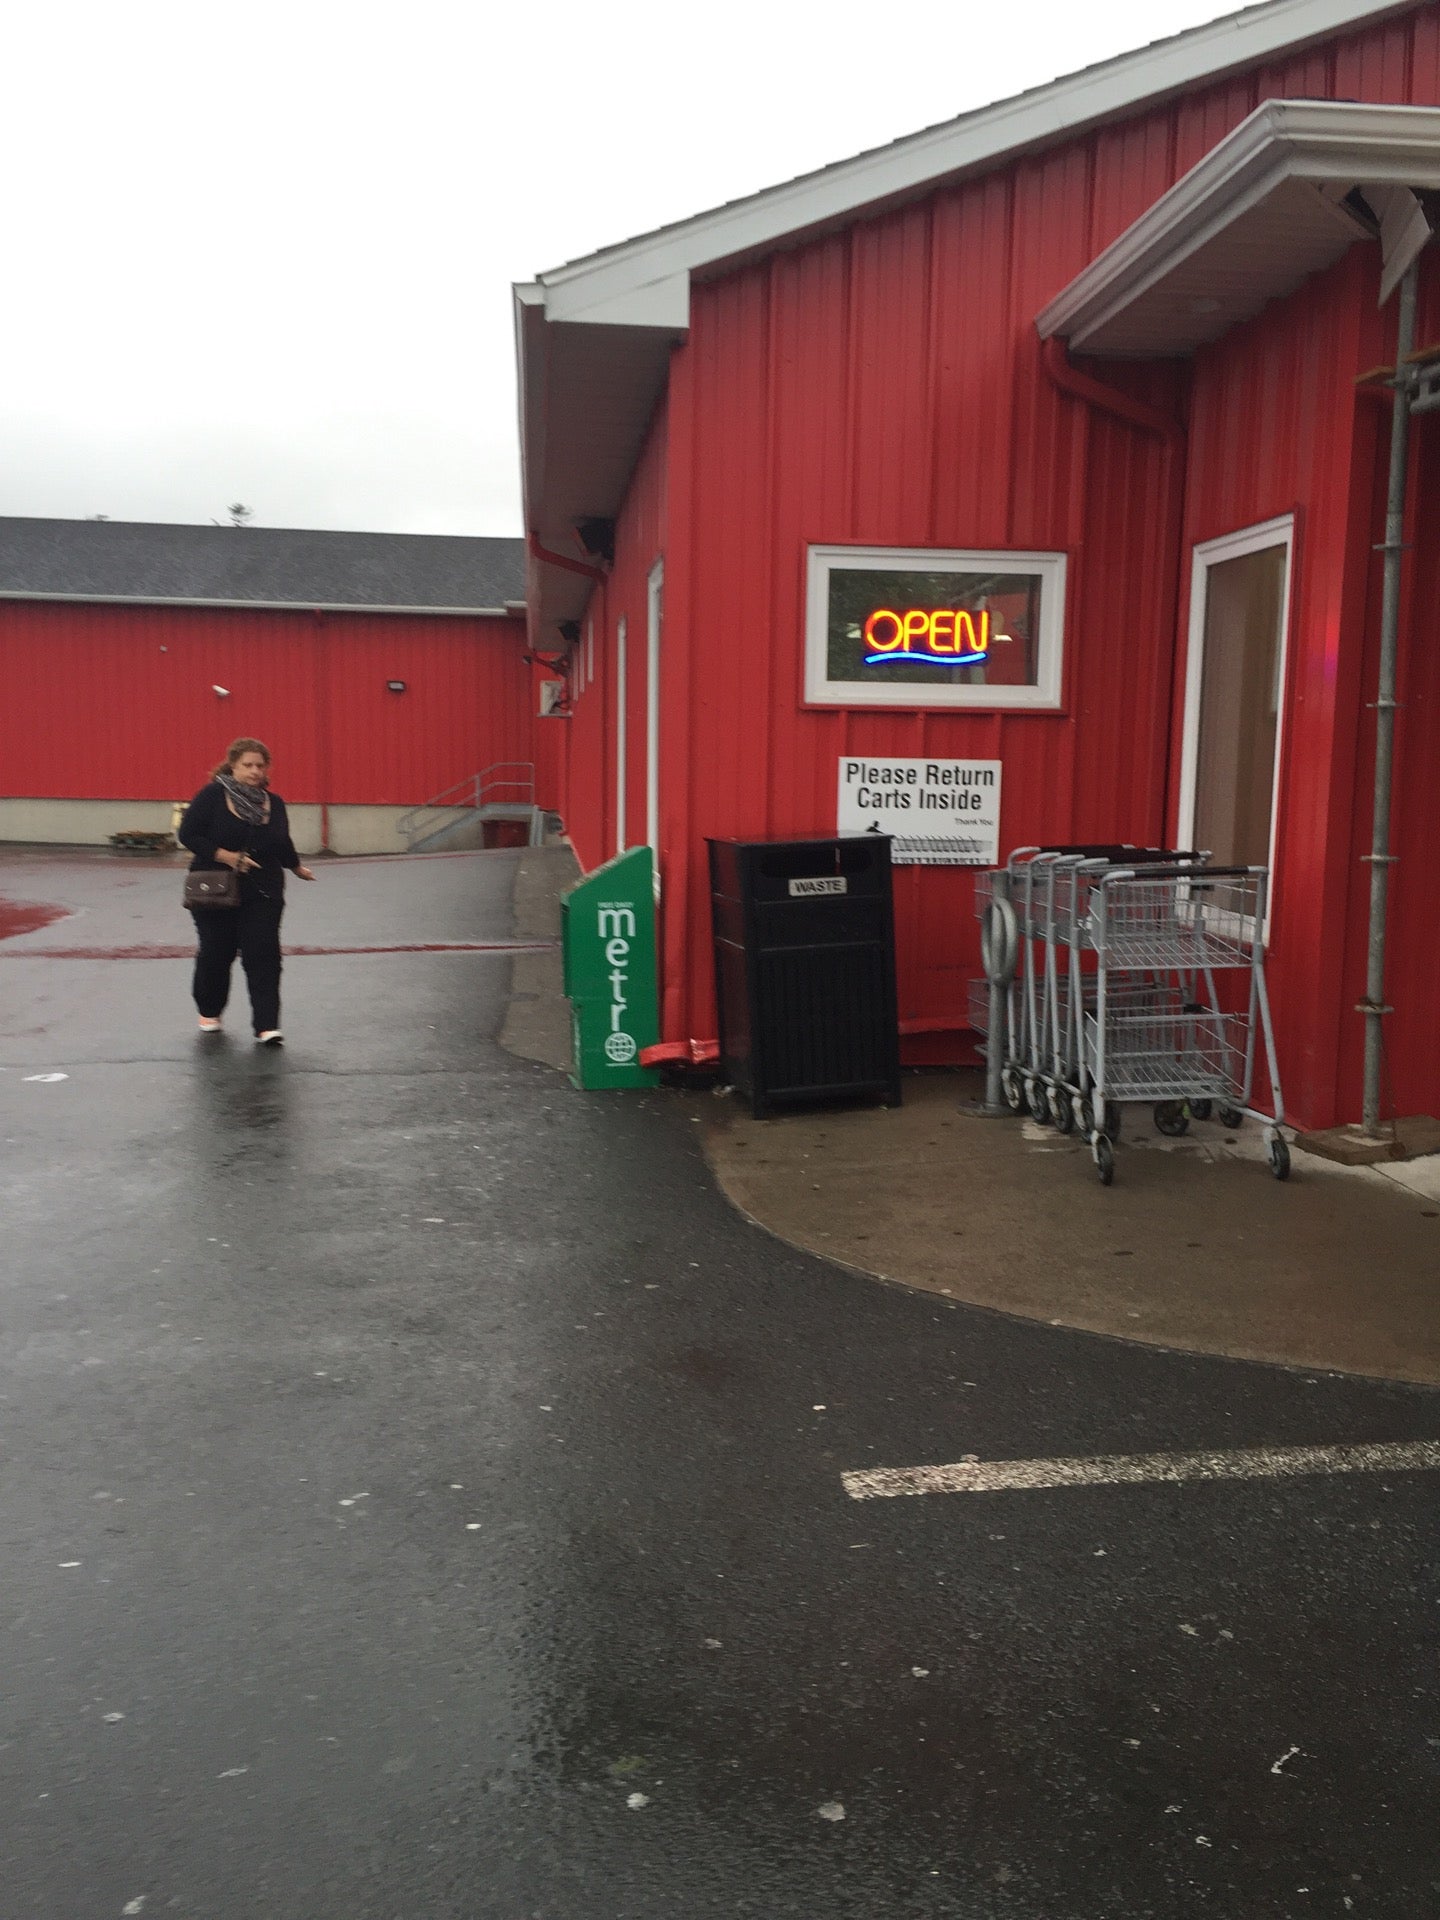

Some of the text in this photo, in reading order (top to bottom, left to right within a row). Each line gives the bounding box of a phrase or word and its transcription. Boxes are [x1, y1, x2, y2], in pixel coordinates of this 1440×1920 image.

[865, 609, 989, 653] OPEN
[846, 763, 995, 786] Please Return
[857, 787, 982, 810] Carts Inside
[795, 880, 842, 892] WASTE
